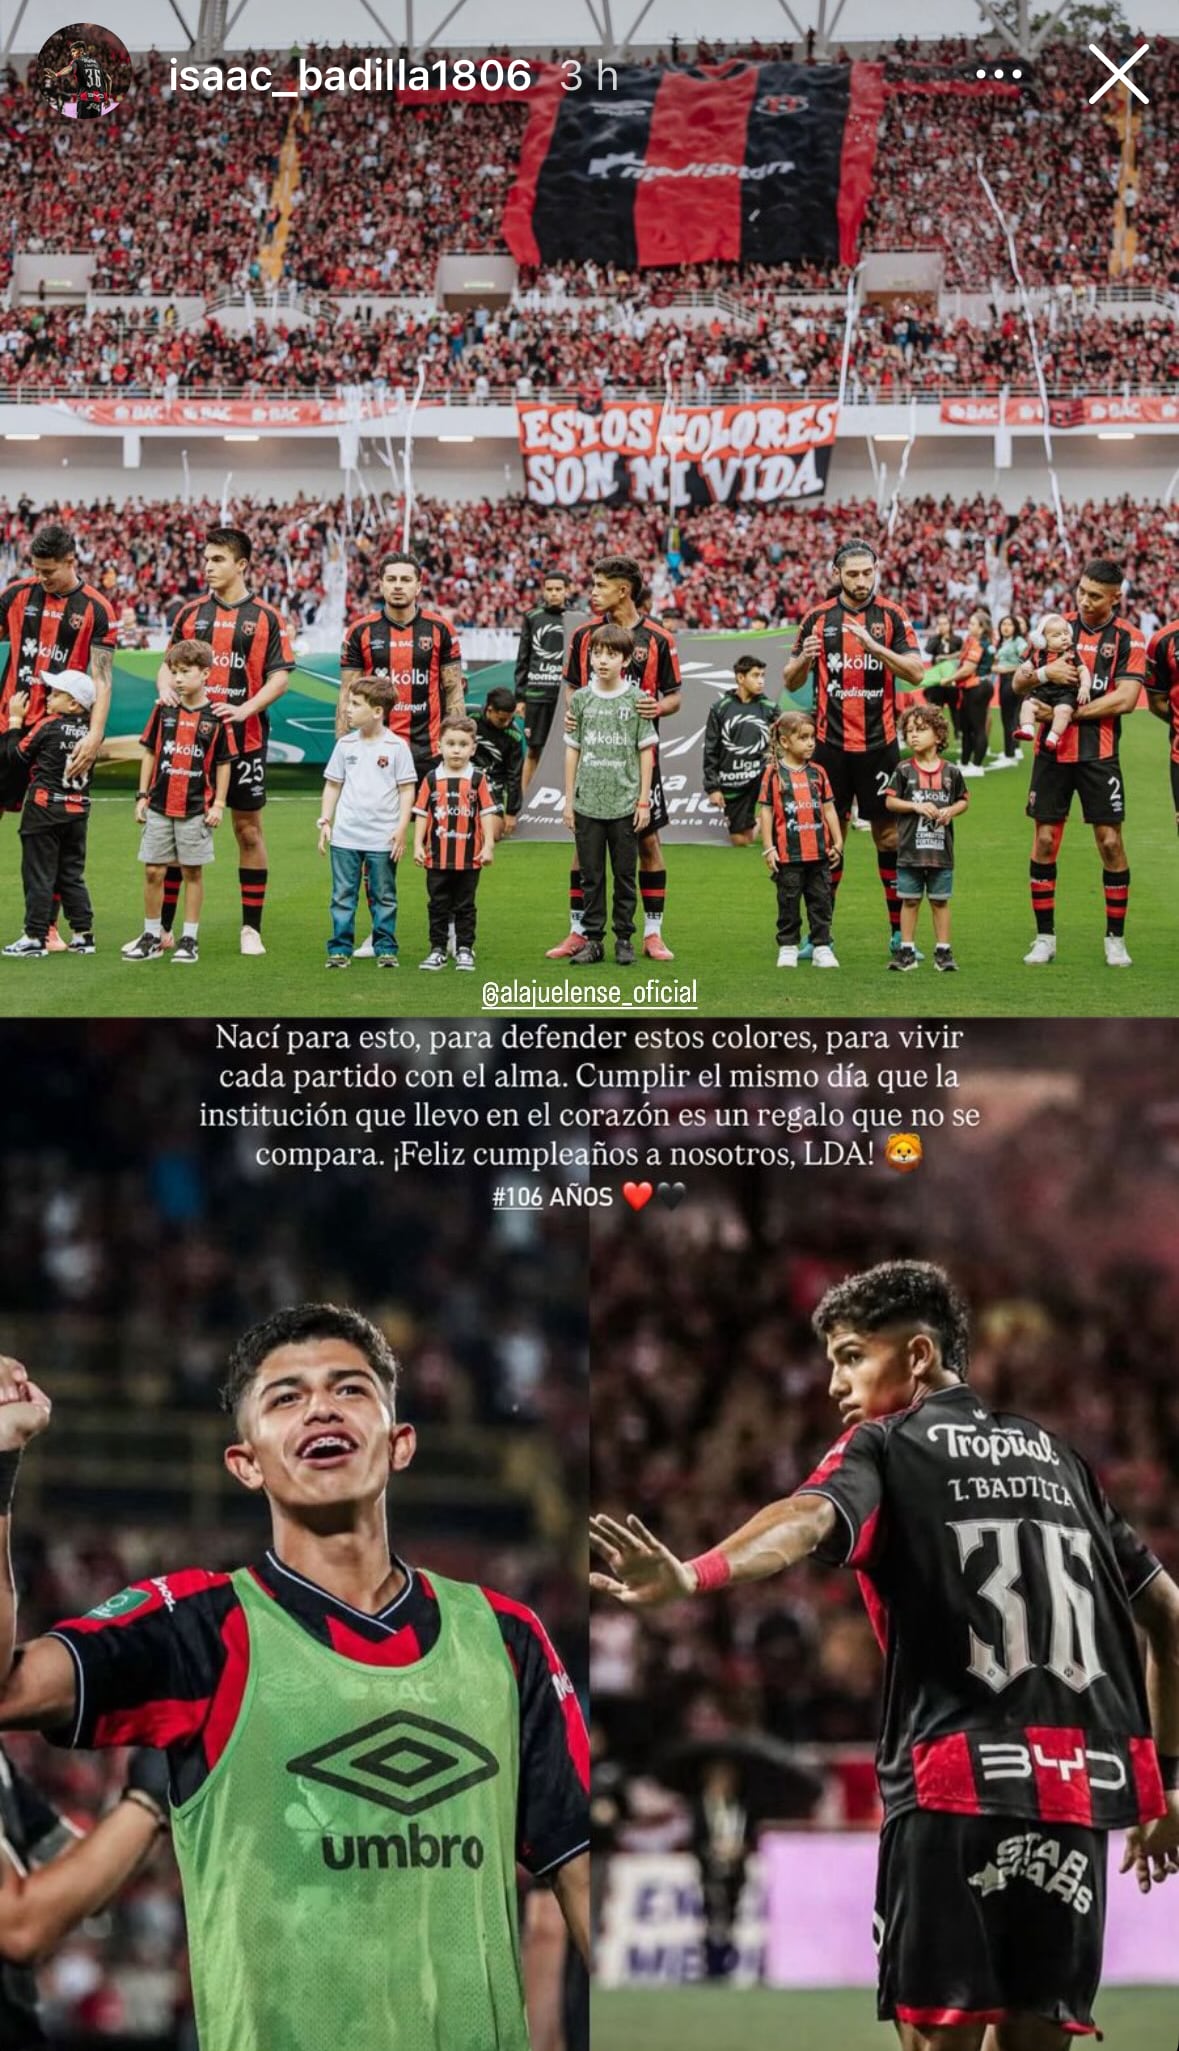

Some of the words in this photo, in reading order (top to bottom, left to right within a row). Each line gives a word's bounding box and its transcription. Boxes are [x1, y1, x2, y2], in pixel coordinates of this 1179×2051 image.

[520, 407, 655, 452] ESTOS
[526, 449, 620, 506] SON
[629, 455, 692, 507] MI
[702, 448, 826, 502] VIDA
[212, 650, 246, 669] kölb
[391, 669, 429, 685] kölbi
[835, 687, 884, 700] medismart
[236, 758, 265, 785] 25
[732, 759, 761, 772] Liga
[1107, 776, 1122, 801] 2
[945, 1517, 1107, 1693] 36
[978, 1743, 1127, 1790] BYD
[321, 1823, 485, 1871] umbro
[996, 1832, 1089, 1880] STAR
